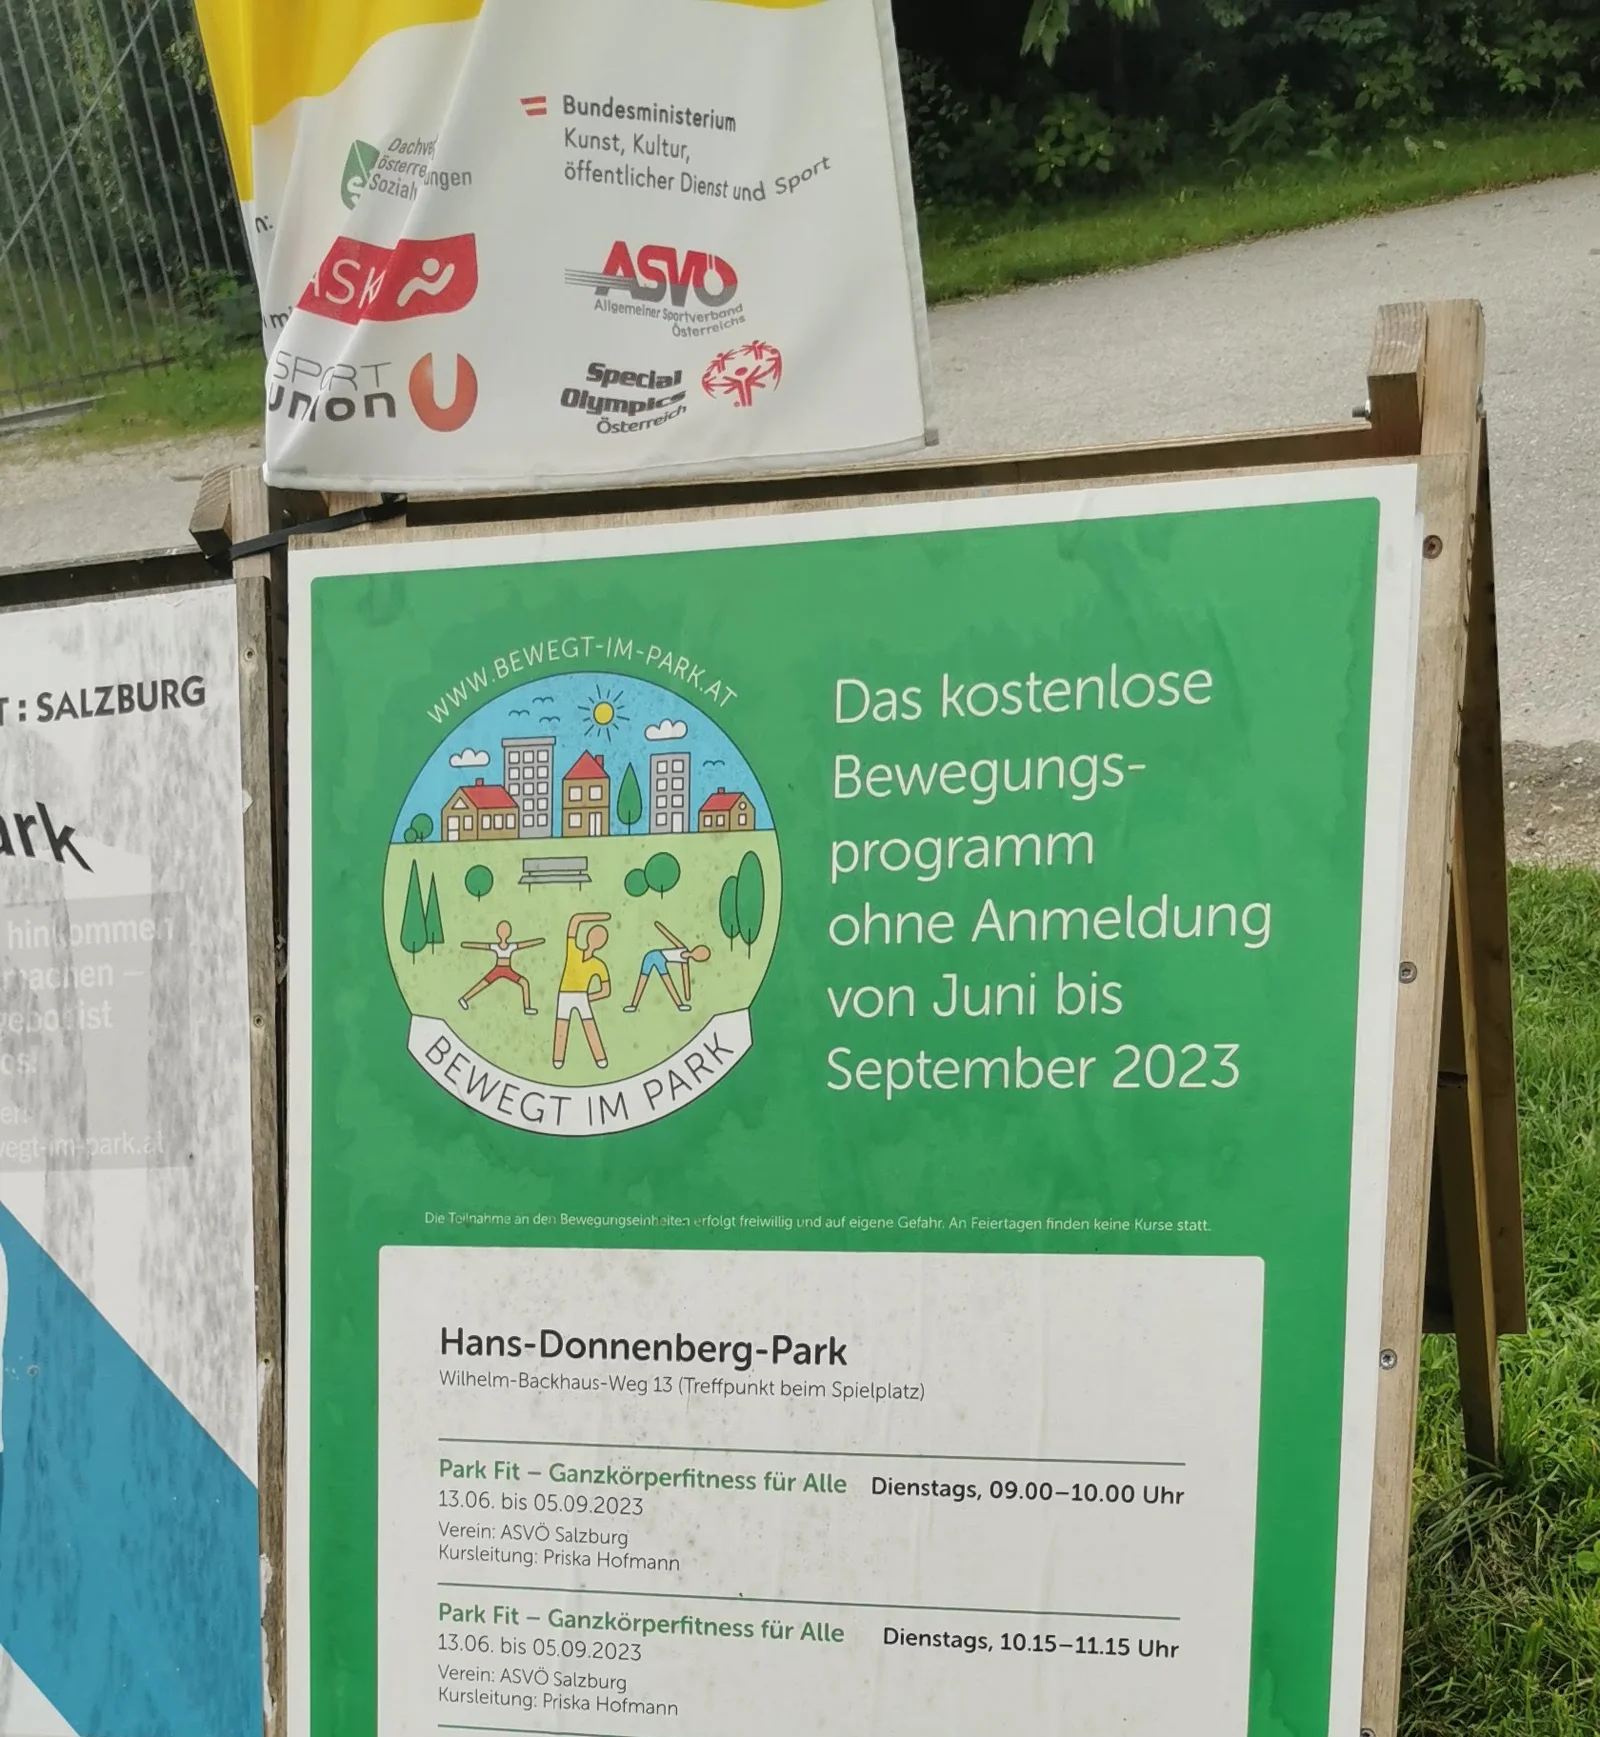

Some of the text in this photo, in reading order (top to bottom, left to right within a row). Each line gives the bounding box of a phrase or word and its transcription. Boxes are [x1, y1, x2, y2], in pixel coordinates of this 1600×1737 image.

[562, 94, 737, 132] Bundesministerium
[564, 127, 690, 164] Kunst, Kultur,
[378, 155, 428, 178] österre
[564, 155, 832, 202] öffentlicher Dienst und Sport
[594, 299, 662, 321] Allgemeiner
[662, 303, 744, 324] Sportverband
[672, 314, 747, 338] Österreichs
[585, 362, 683, 390] Special
[560, 387, 687, 417] Olympics
[596, 404, 688, 434] Österreich
[426, 635, 739, 726] WWW.BEWEGT-IM-PARK.AT
[834, 662, 1213, 724] Das kostenlose
[36, 675, 206, 723] SALZBURG
[832, 750, 1147, 805] Bewegungs-
[830, 830, 1095, 885] programm
[828, 893, 1272, 949] ohne Anmeldung
[826, 970, 1124, 1019] von Juni bis
[424, 1030, 736, 1128] BEWEGT IM PARK
[826, 1042, 1242, 1101] September 2023
[424, 1211, 446, 1225] Die
[514, 1214, 530, 1226] an
[532, 1212, 557, 1226] den
[559, 1212, 691, 1230] Bewegungseinheiten
[693, 1214, 737, 1230] erfolgt
[739, 1214, 794, 1230] freiwillig
[796, 1215, 822, 1229] und
[824, 1215, 846, 1229] auf
[848, 1216, 895, 1231] eigene
[897, 1216, 946, 1230] Gefahr.
[948, 1217, 968, 1231] An
[970, 1217, 1043, 1233] Feiertagen
[1045, 1217, 1090, 1232] finden
[1093, 1217, 1131, 1232] keine
[1134, 1218, 1174, 1232] Kurse
[1176, 1218, 1213, 1233] statt.
[440, 1326, 849, 1372] Hans-Donnenberg-Park
[439, 1369, 926, 1403] Wilhelm-Backhaus-Weg 13 (Treffpunkt beim Spielplatz)
[439, 1458, 487, 1481] Park
[493, 1460, 521, 1482] Fit
[548, 1461, 757, 1491] Ganzkörperfitness
[763, 1469, 797, 1493] für
[802, 1471, 848, 1495] Alle
[871, 1476, 983, 1503] Dienstags,
[1143, 1485, 1186, 1506] Uhr
[438, 1490, 645, 1517] 13.06. bis 05.09.2023
[438, 1521, 630, 1549] Verein: ASVÖ Salzburg
[438, 1544, 681, 1573] Kursleitung: Priska Hofmann
[438, 1602, 487, 1625] Park
[492, 1604, 520, 1626] Fit
[547, 1608, 755, 1638] Ganzkörperfitness
[761, 1617, 795, 1640] für
[799, 1621, 846, 1644] Alle
[437, 1633, 643, 1662] 13.06. bis 05.09.2023
[883, 1627, 994, 1654] Dienstags,
[1138, 1638, 1180, 1659] Uhr
[437, 1664, 628, 1694] Verein: ASVÖ Salzburg
[437, 1687, 680, 1717] Kursleitung: Priska Hofmann
